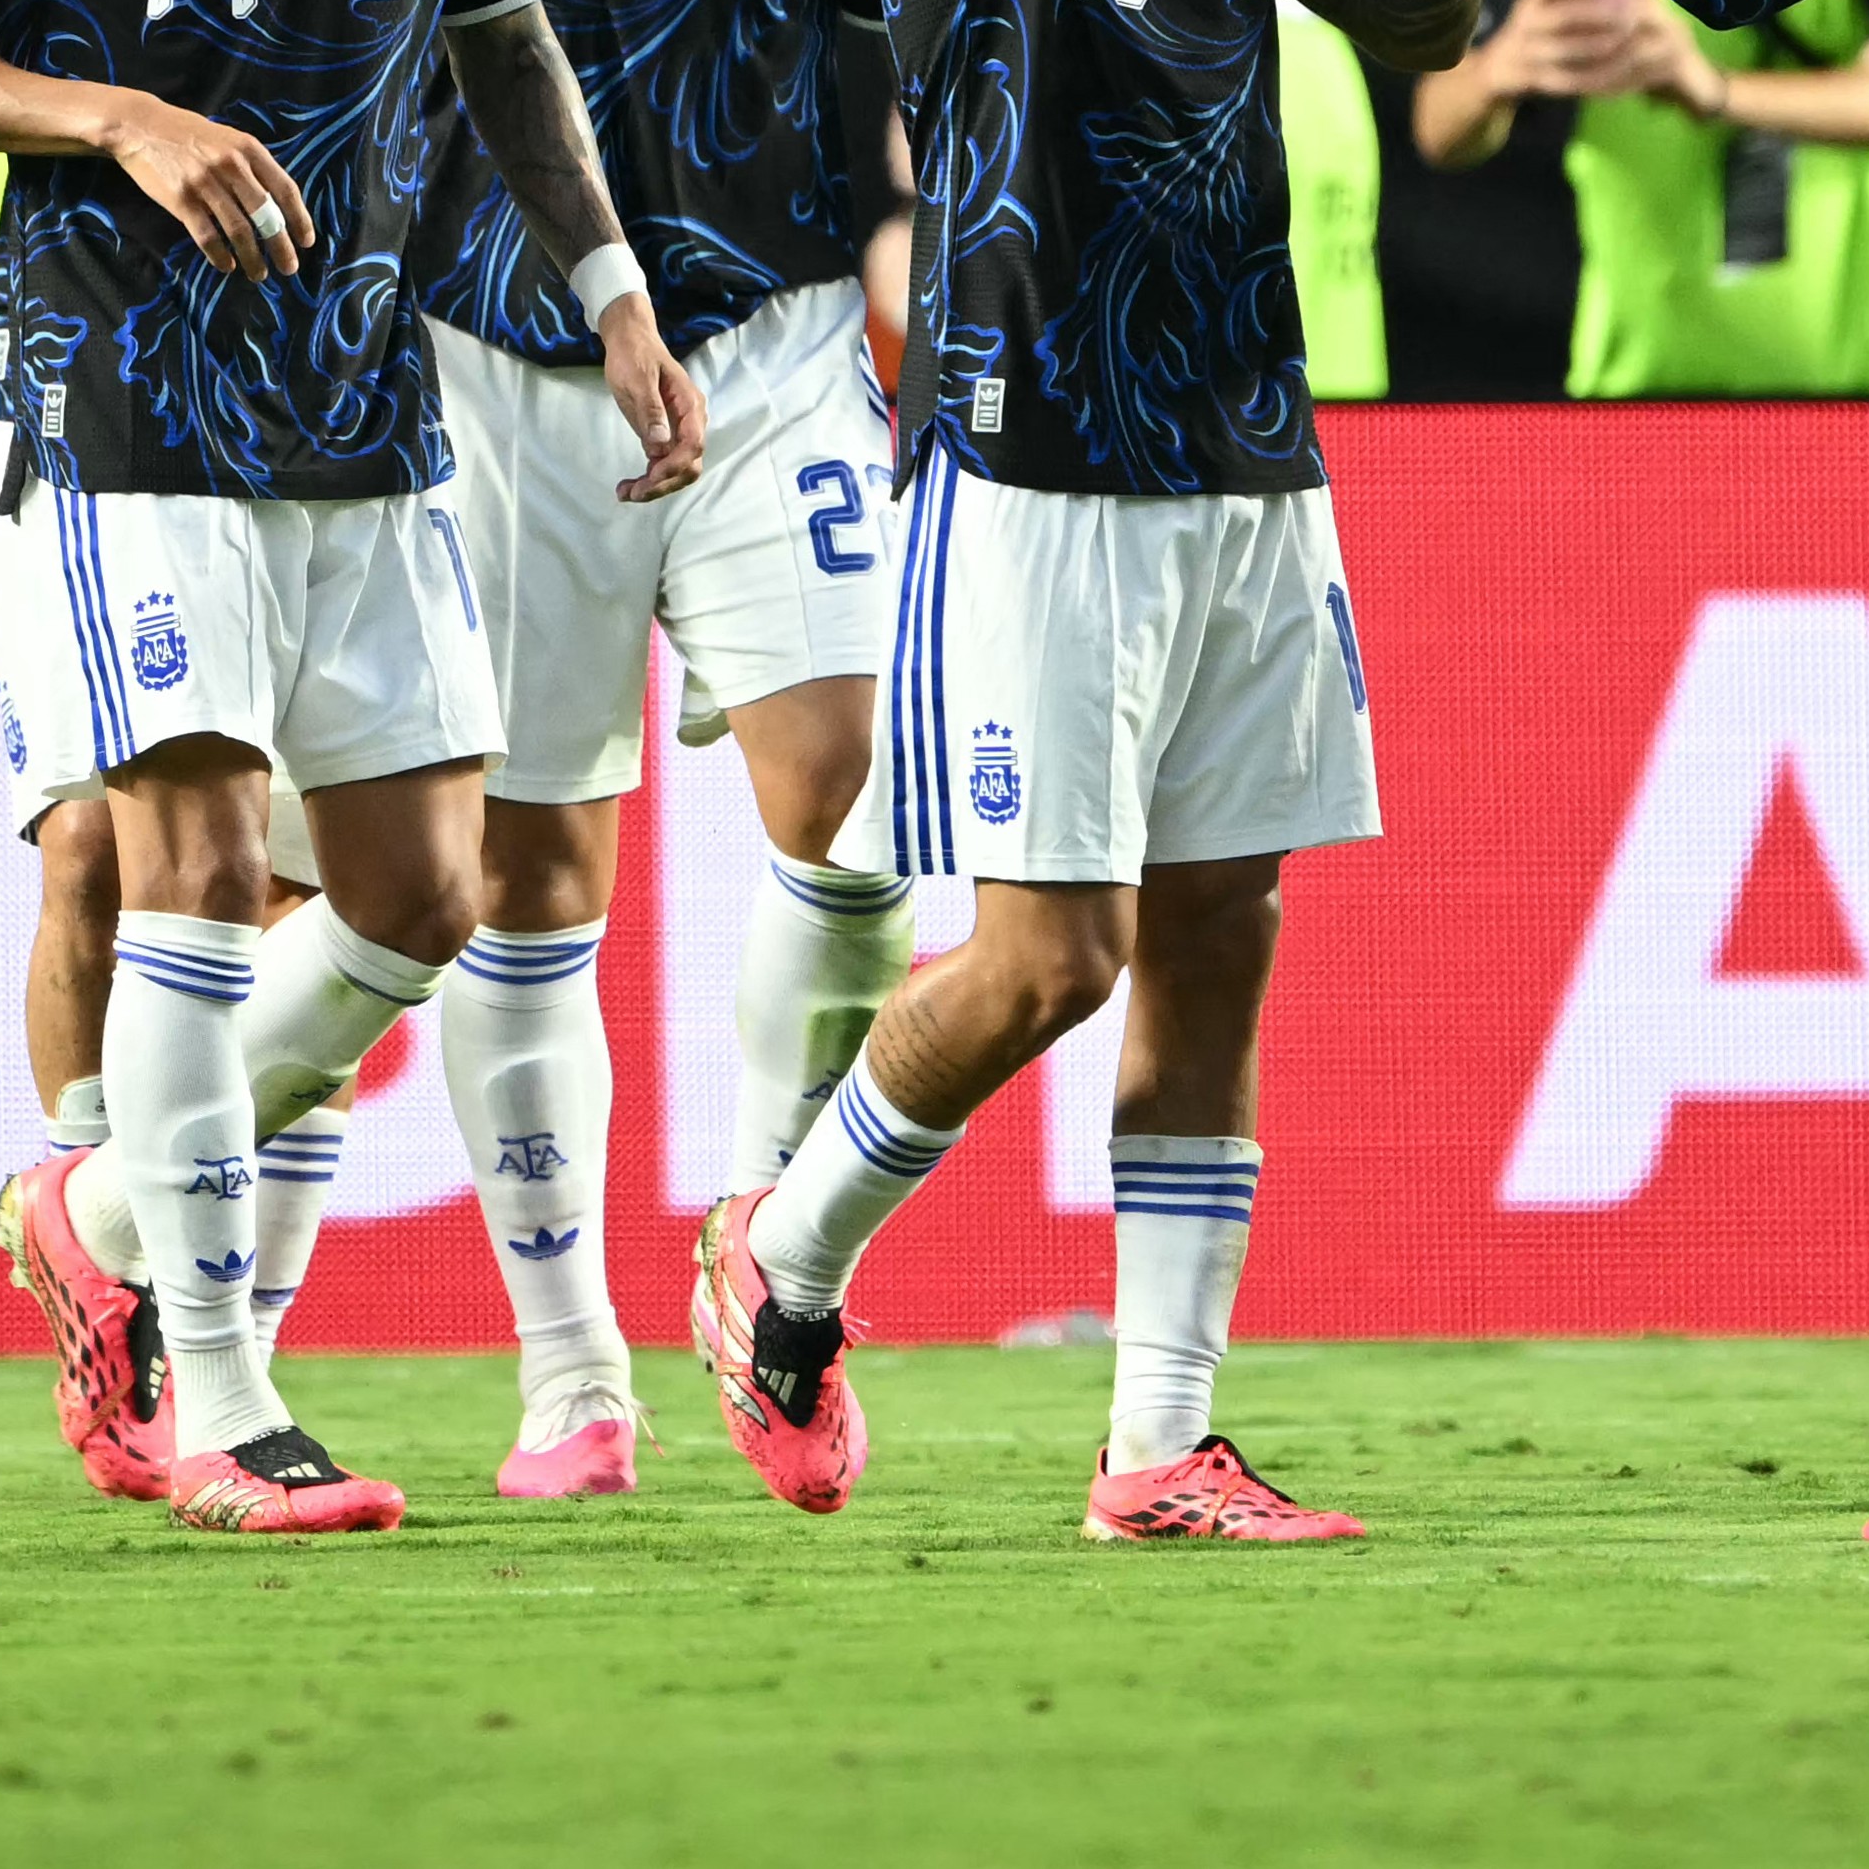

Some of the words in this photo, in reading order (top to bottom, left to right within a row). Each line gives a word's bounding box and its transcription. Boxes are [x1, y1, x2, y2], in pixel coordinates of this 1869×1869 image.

[796, 459, 894, 578] 2
[143, 632, 175, 668] AFA
[979, 767, 1010, 803] AFA
[184, 1155, 255, 1201] AFA
[495, 1132, 569, 1182] AFA
